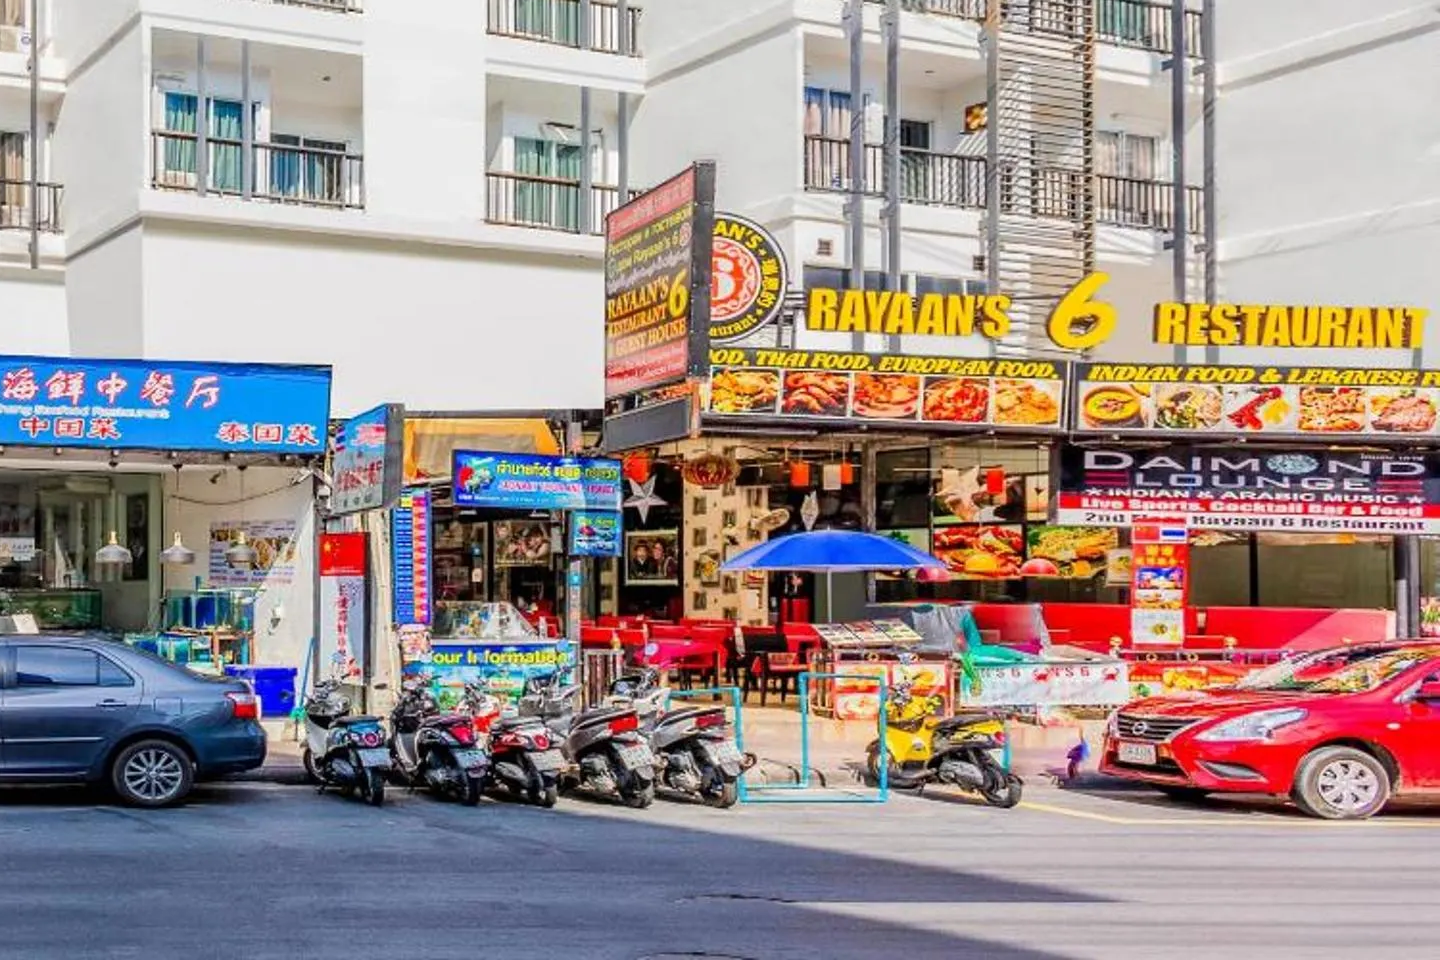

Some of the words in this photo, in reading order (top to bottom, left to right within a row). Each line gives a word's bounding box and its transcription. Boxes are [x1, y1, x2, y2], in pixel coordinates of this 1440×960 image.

[713, 220, 764, 249] AN'S
[608, 275, 669, 321] RAYAAN'S
[668, 269, 689, 319] 6
[806, 287, 1012, 340] RAYAAN'S
[1153, 303, 1431, 349] RESTAURANT
[1048, 272, 1118, 350] 6
[647, 315, 687, 349] HOUSE
[756, 352, 808, 368] THAI
[878, 356, 991, 376] EUROPEAN
[1088, 365, 1183, 382] INDIAN
[1184, 366, 1257, 383] FOOD
[1259, 368, 1284, 383] &
[1287, 369, 1419, 386] LEBANESE
[20, 417, 121, 440] 中国菜
[217, 422, 321, 445] 泰国菜
[1135, 473, 1371, 492] LOUNGE
[1081, 497, 1125, 509] Live
[1210, 501, 1304, 514] Cocktail
[1309, 503, 1346, 516] Bar
[1371, 504, 1424, 517] Food
[1108, 488, 1195, 499] INDIAN
[1222, 490, 1316, 502] ARABIC
[1323, 492, 1399, 504] MUSIC
[1085, 512, 1127, 524] 2nd
[1300, 517, 1425, 531] Restaurant
[431, 650, 463, 664] our
